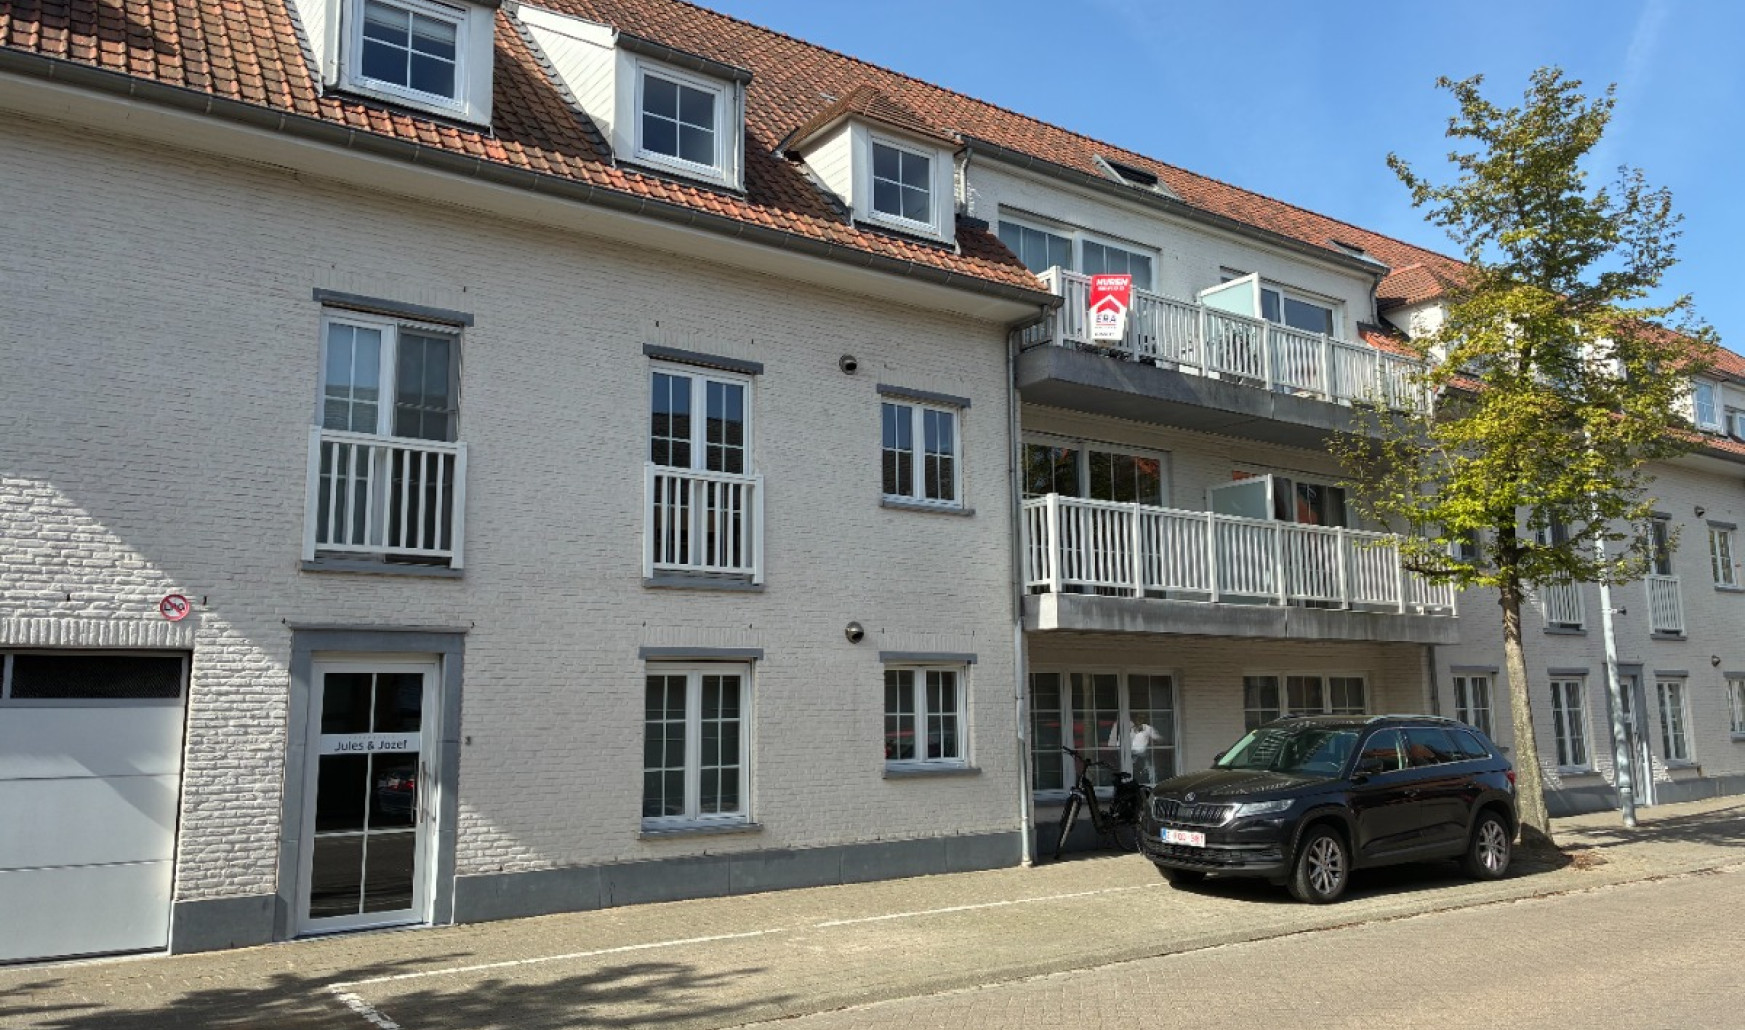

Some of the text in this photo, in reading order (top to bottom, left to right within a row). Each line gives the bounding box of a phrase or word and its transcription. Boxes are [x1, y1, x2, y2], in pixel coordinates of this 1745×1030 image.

[334, 740, 408, 751] Jules & Jozef
